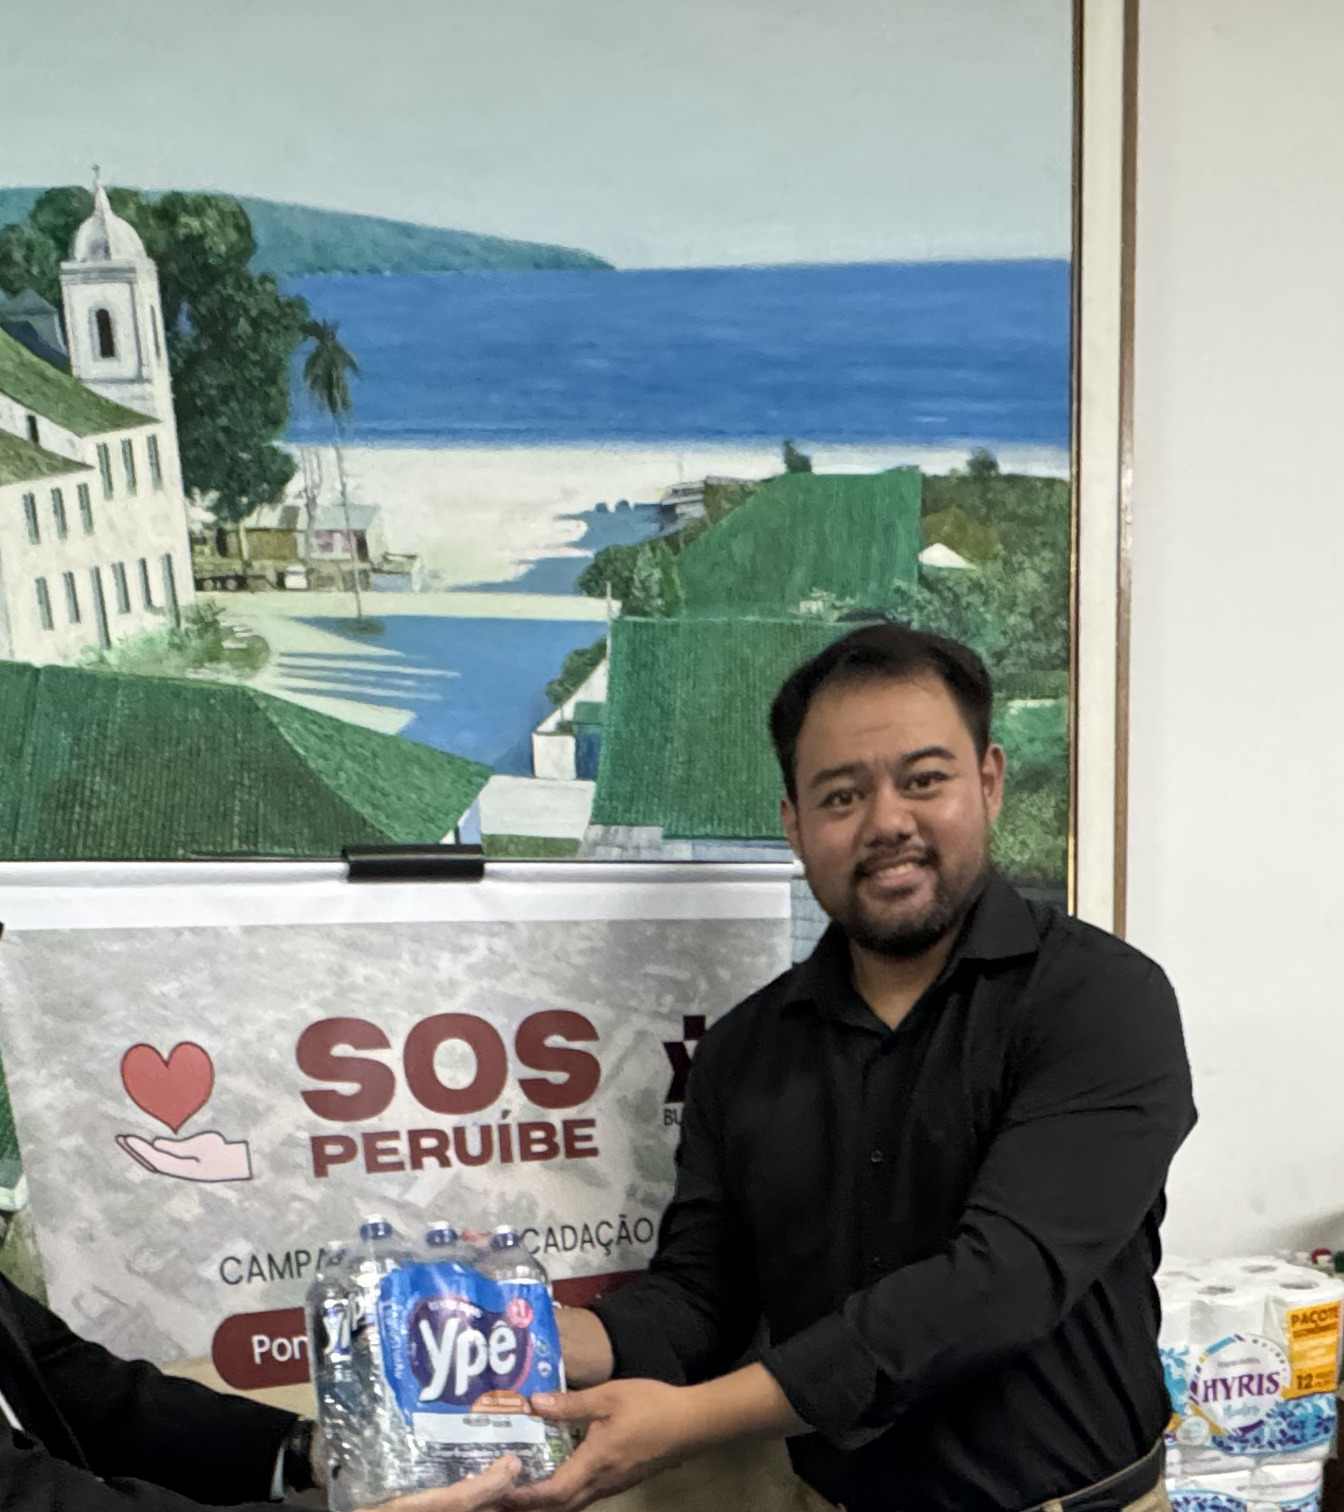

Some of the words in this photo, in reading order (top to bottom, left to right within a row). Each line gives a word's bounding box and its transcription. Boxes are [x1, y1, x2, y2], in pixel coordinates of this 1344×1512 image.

[295, 1009, 601, 1122] SOS
[310, 1109, 600, 1178] PERUÍBE
[1202, 1371, 1281, 1403] HYRIS
[1296, 1373, 1314, 1390] 12
